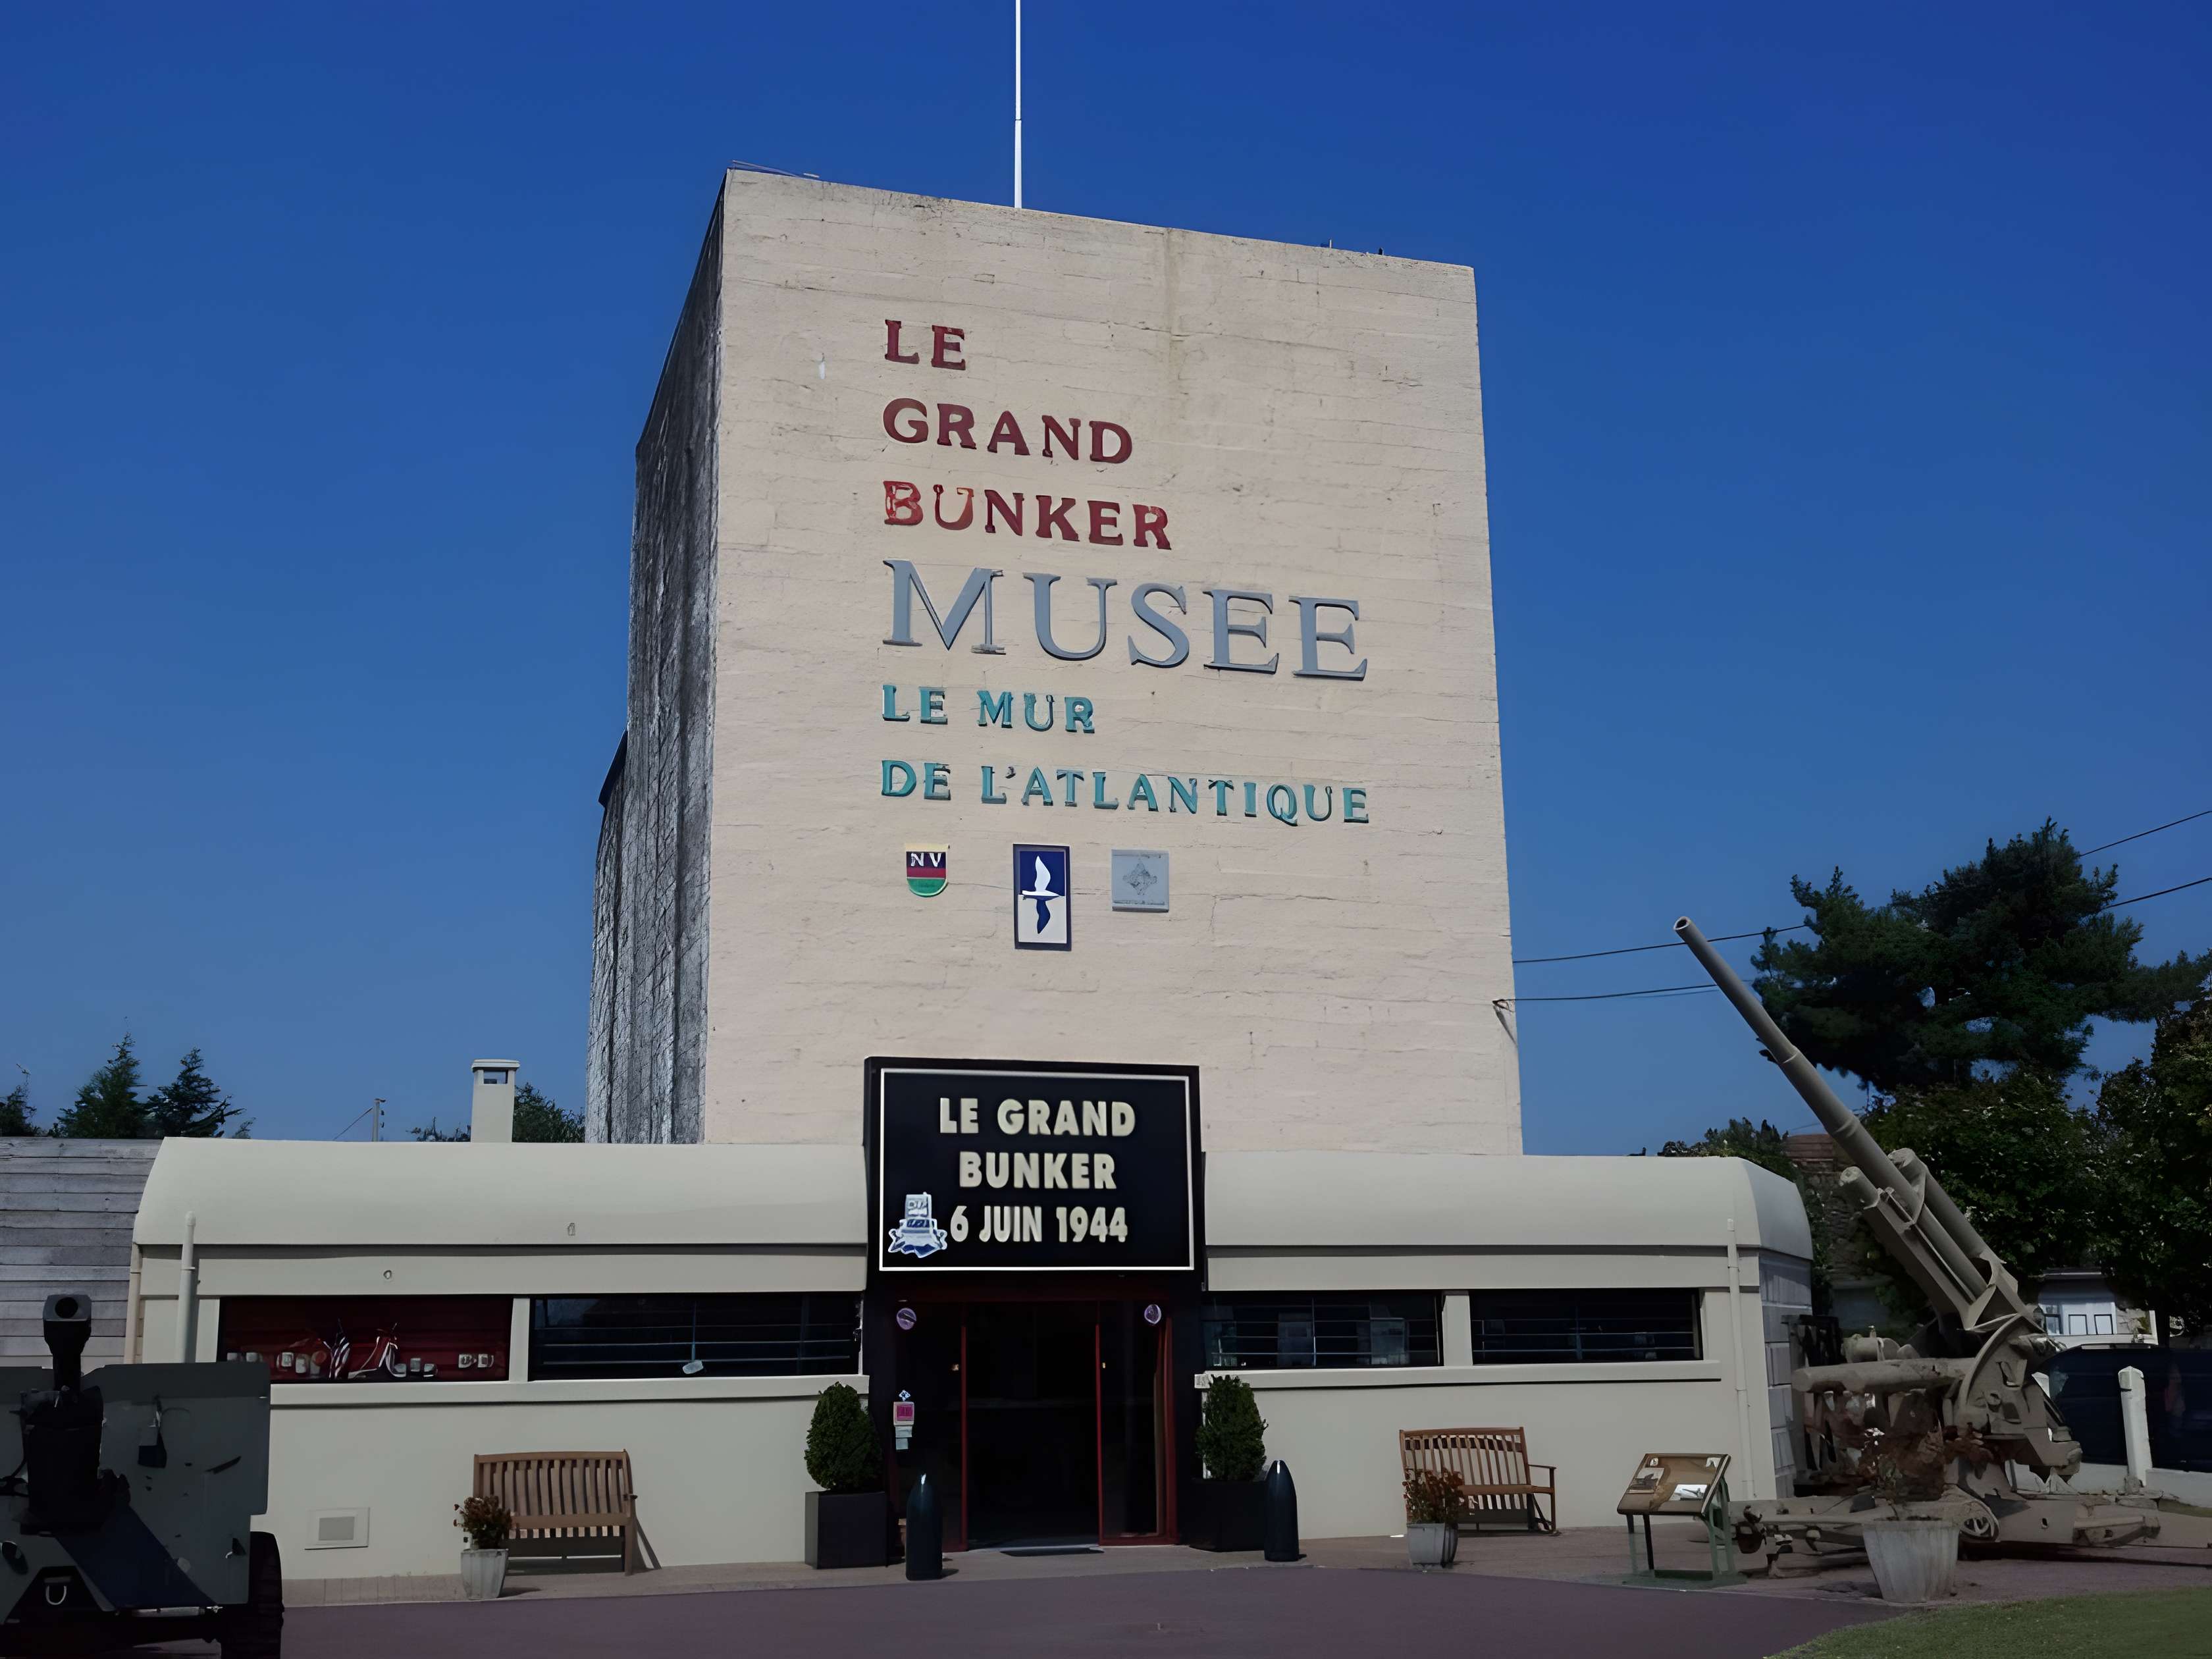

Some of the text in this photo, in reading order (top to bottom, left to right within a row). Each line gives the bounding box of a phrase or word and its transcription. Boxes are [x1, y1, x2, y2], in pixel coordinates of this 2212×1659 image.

[884, 319, 966, 370] LE
[883, 398, 1133, 463] GRAND
[883, 480, 1172, 550] BUNKER
[882, 560, 1367, 681] MUSEE
[882, 685, 1095, 733] LE MUR
[882, 760, 1369, 826] DE L'ATLANTIQUE
[939, 1097, 1136, 1136] LE GRAND
[959, 1151, 1117, 1189] BUNKER
[950, 1205, 969, 1242] 6
[979, 1205, 1042, 1242] JUIN
[1056, 1206, 1128, 1242] 1944
